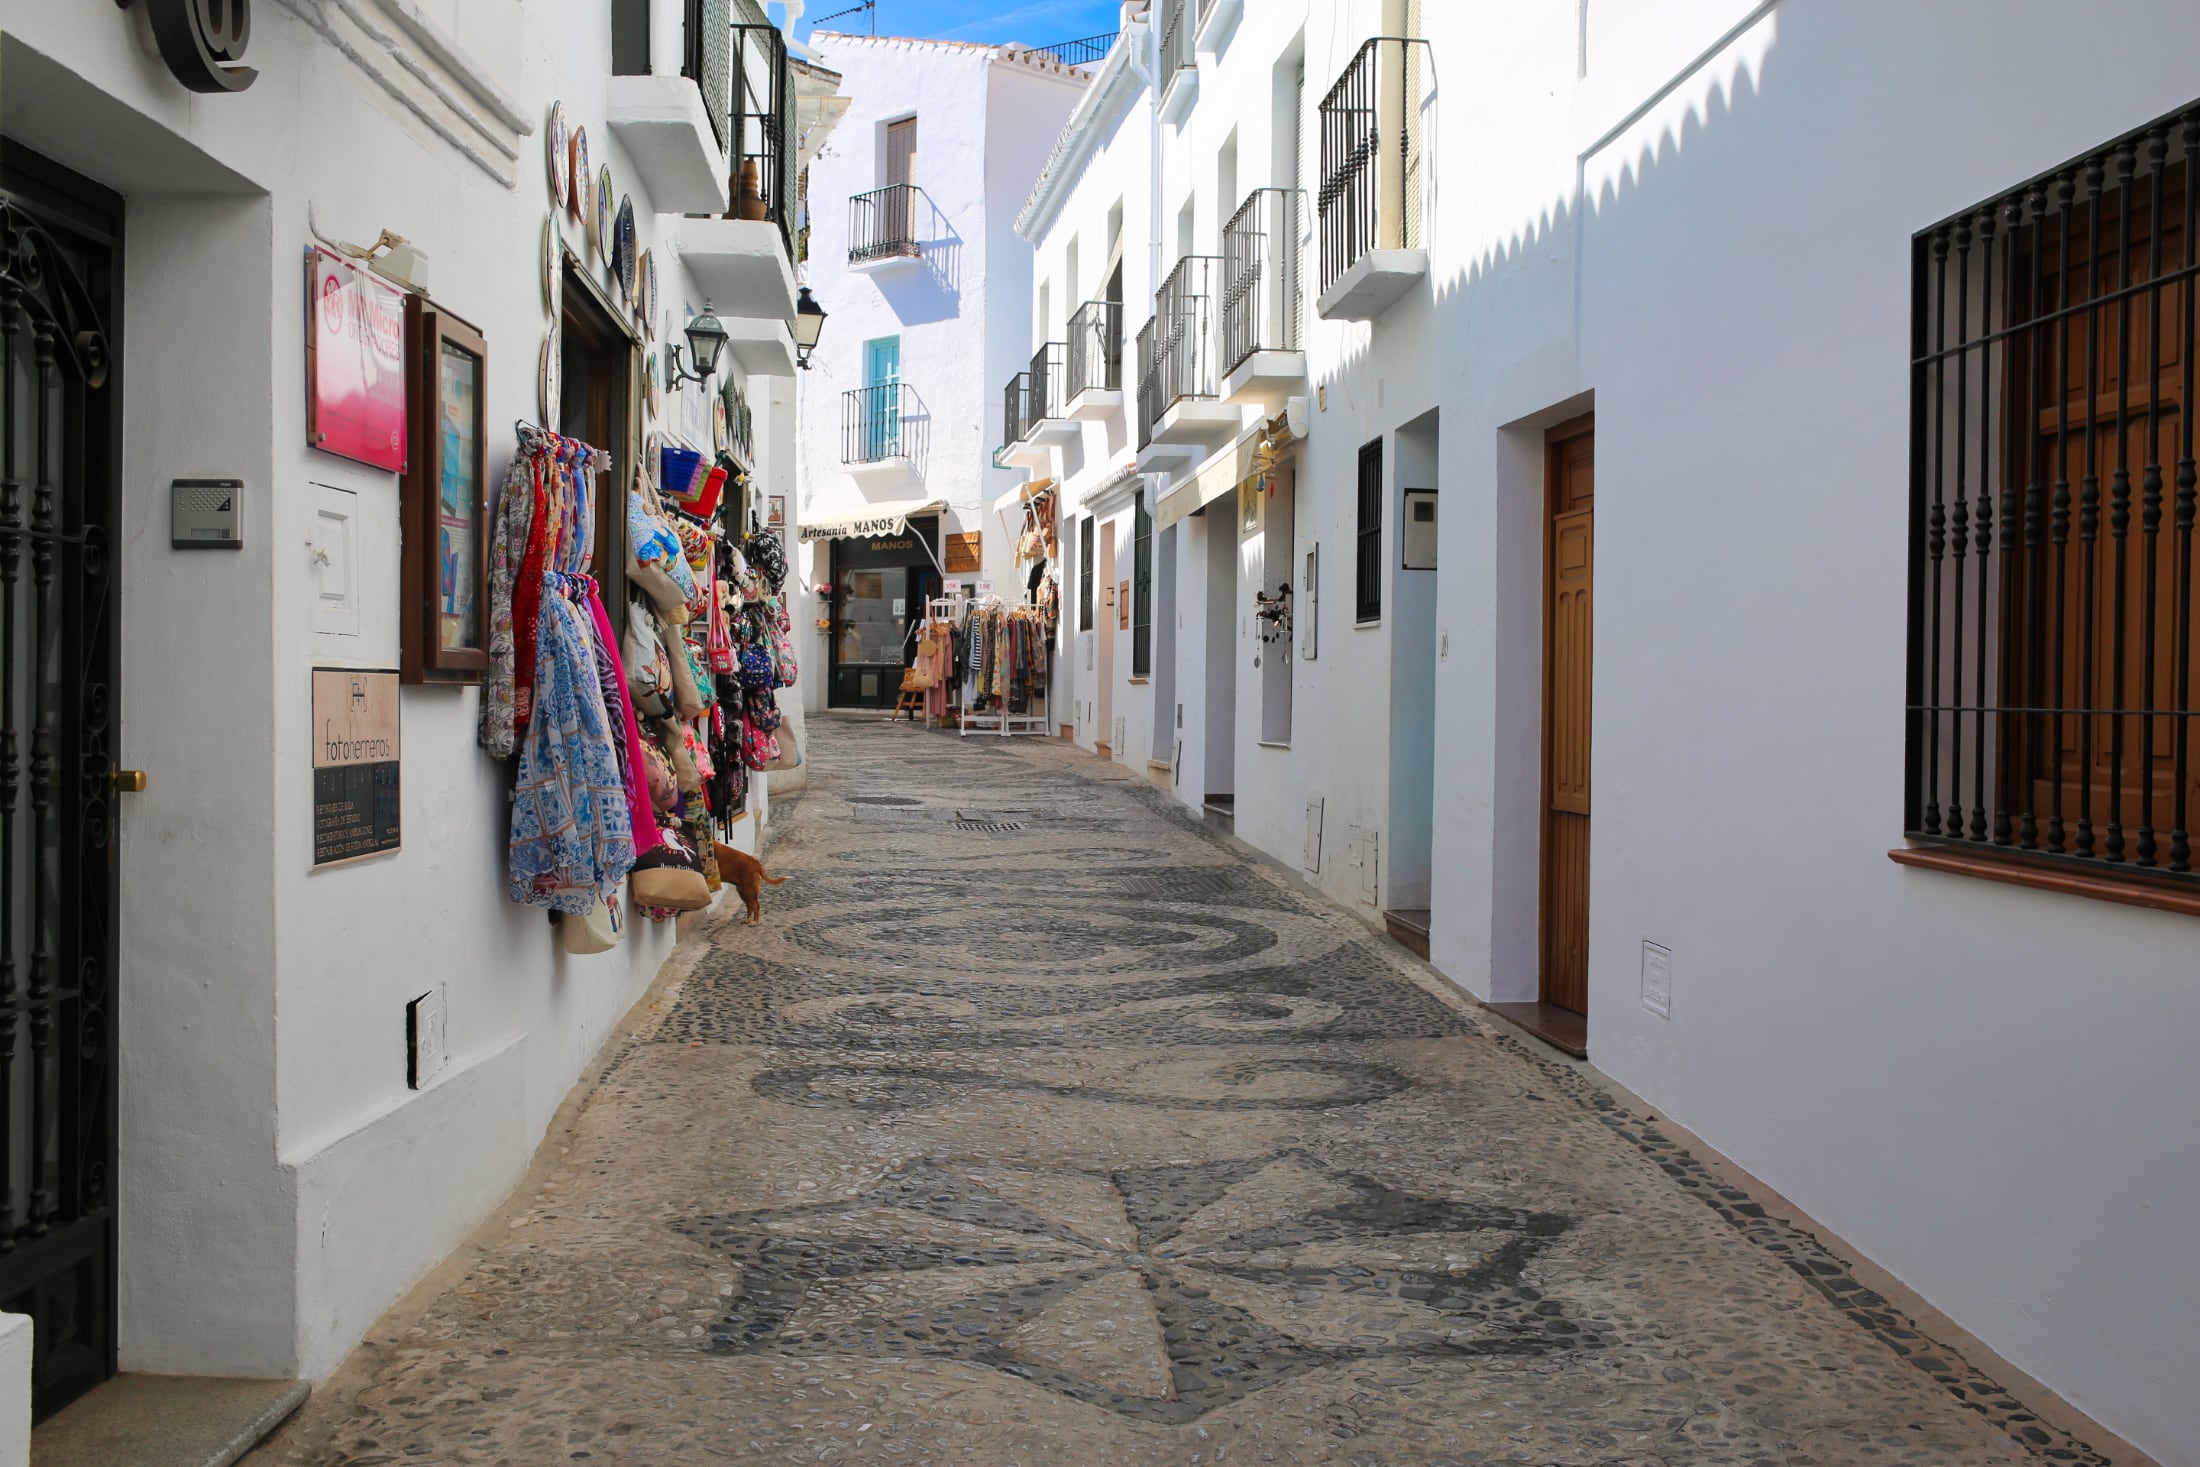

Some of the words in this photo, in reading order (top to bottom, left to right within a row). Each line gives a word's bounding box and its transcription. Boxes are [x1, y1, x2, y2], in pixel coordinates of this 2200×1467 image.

[853, 518, 894, 534] MANOS
[871, 540, 913, 551] MANOS
[325, 718, 390, 761] fotoherreros
